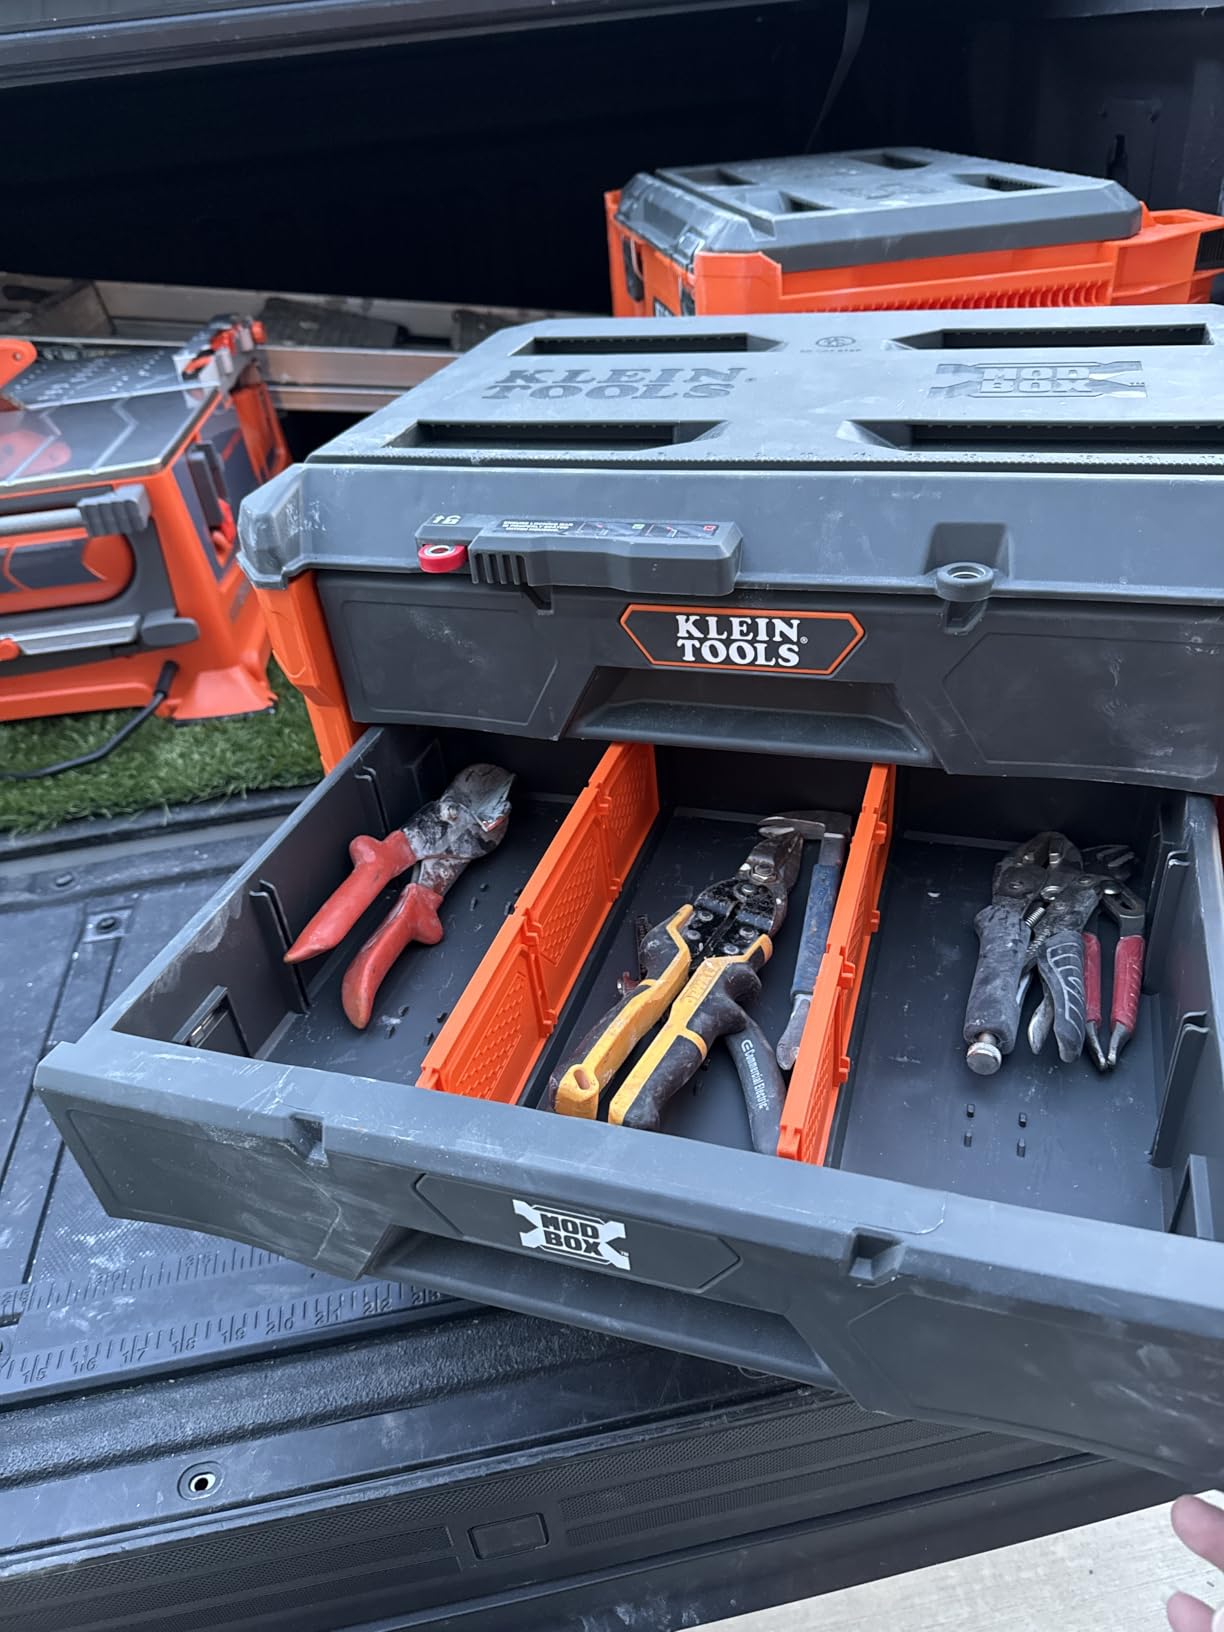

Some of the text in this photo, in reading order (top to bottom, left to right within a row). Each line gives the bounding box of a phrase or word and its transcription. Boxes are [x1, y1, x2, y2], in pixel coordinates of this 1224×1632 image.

[494, 367, 748, 384] KLEIN
[981, 367, 1091, 380] MOD
[481, 383, 736, 400] TOOLS
[979, 379, 1093, 393] BOX
[675, 614, 801, 643] KLEIN
[676, 638, 800, 667] TOOLS
[540, 1213, 600, 1240] MOD
[543, 1230, 602, 1257] BOX
